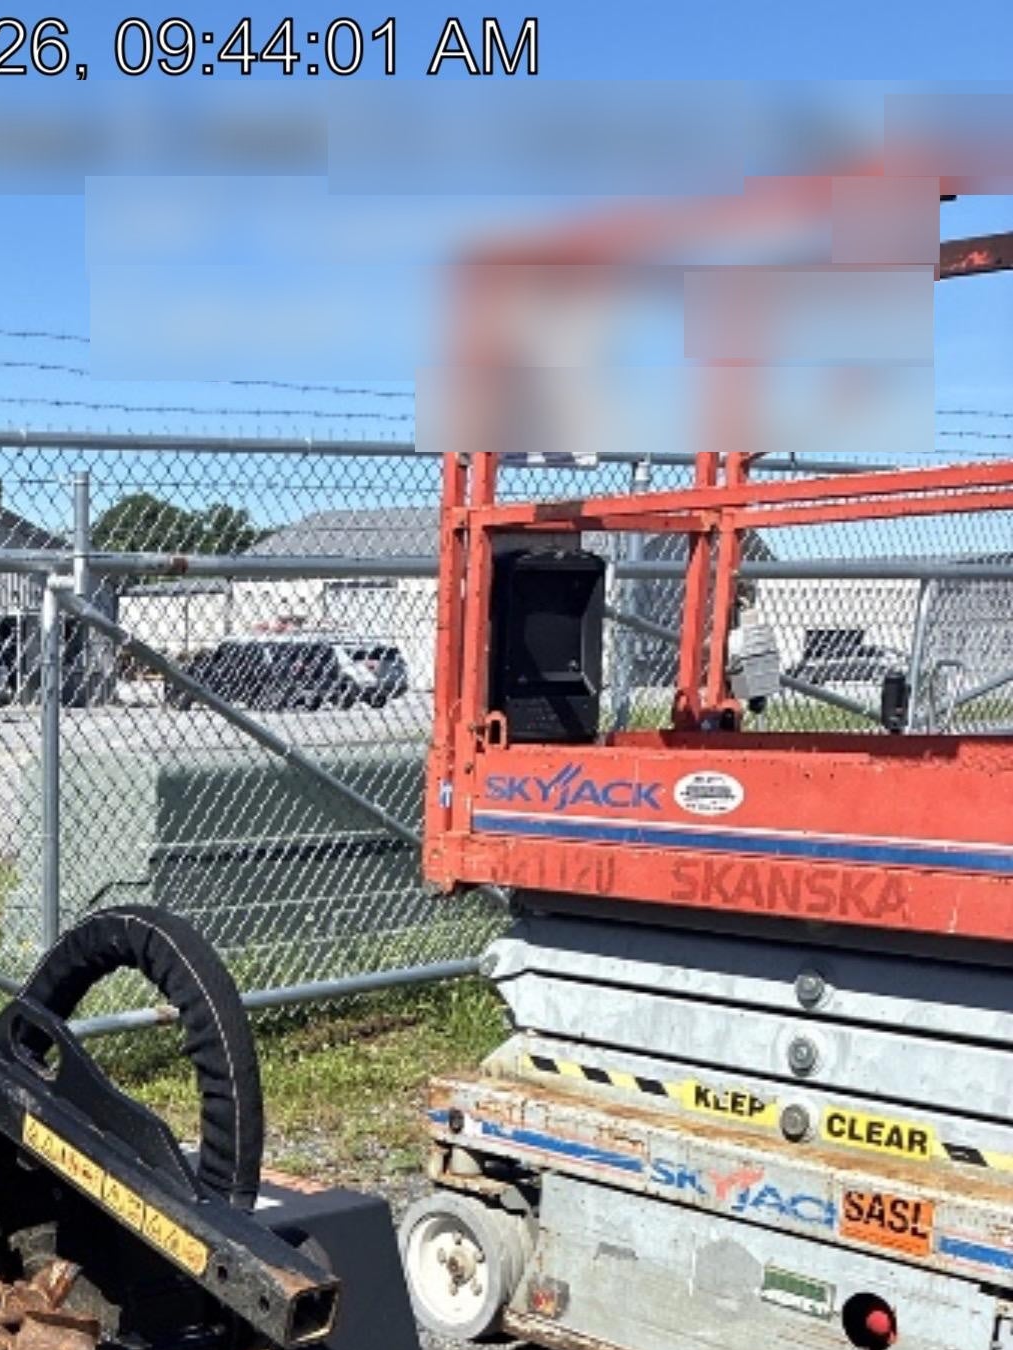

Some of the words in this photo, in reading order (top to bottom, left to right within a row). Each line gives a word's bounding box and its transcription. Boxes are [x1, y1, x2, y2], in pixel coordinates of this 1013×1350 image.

[485, 762, 662, 811] SKYJACK
[671, 858, 906, 919] SKANSKA
[694, 1085, 766, 1117] KEEP
[826, 1112, 928, 1154] CLEAR
